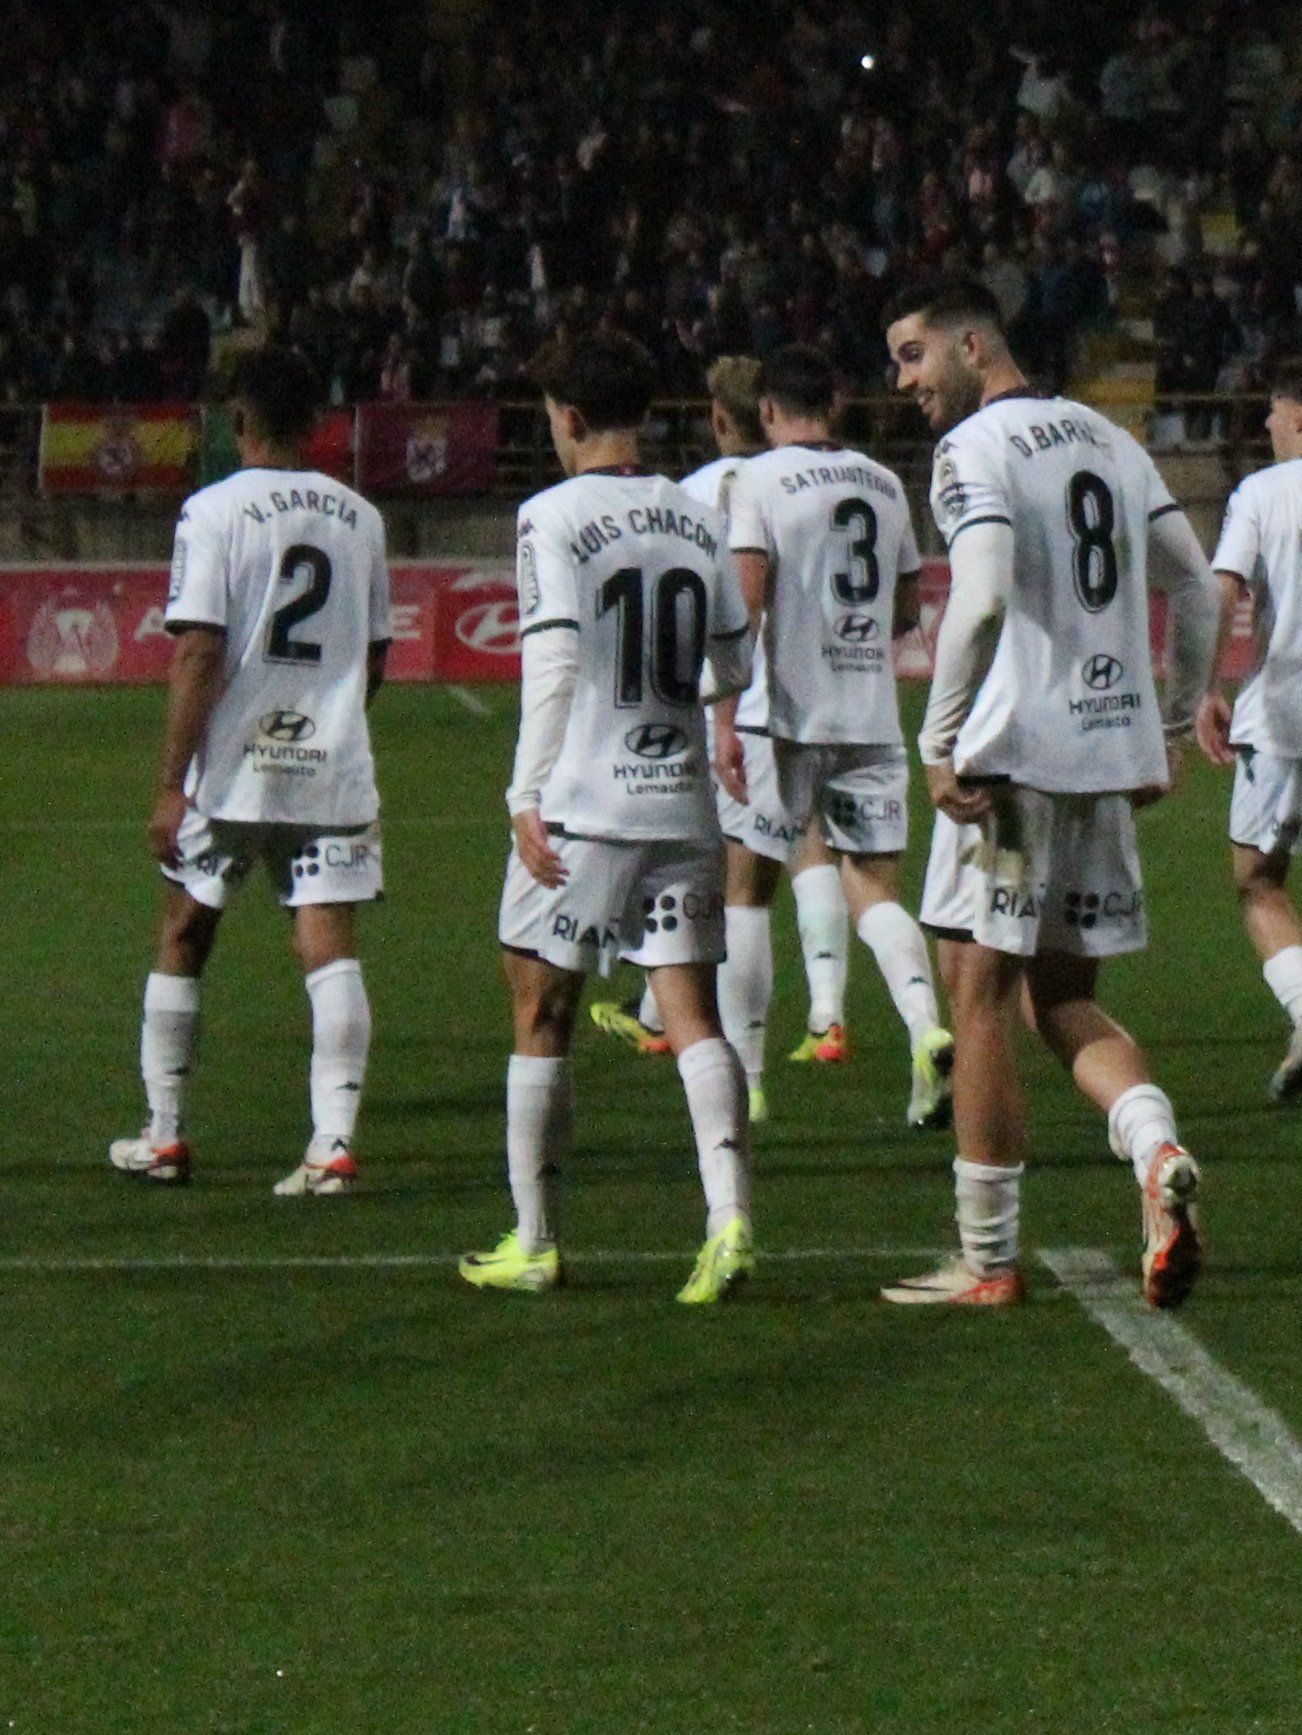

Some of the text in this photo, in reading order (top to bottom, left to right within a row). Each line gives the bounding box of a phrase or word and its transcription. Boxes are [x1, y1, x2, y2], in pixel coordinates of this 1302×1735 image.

[569, 515, 622, 564] LUIS
[831, 498, 880, 606] 3
[1066, 470, 1117, 614] 8
[262, 544, 332, 666] 2
[596, 567, 707, 709] 10
[243, 743, 327, 762] HYUNDAI
